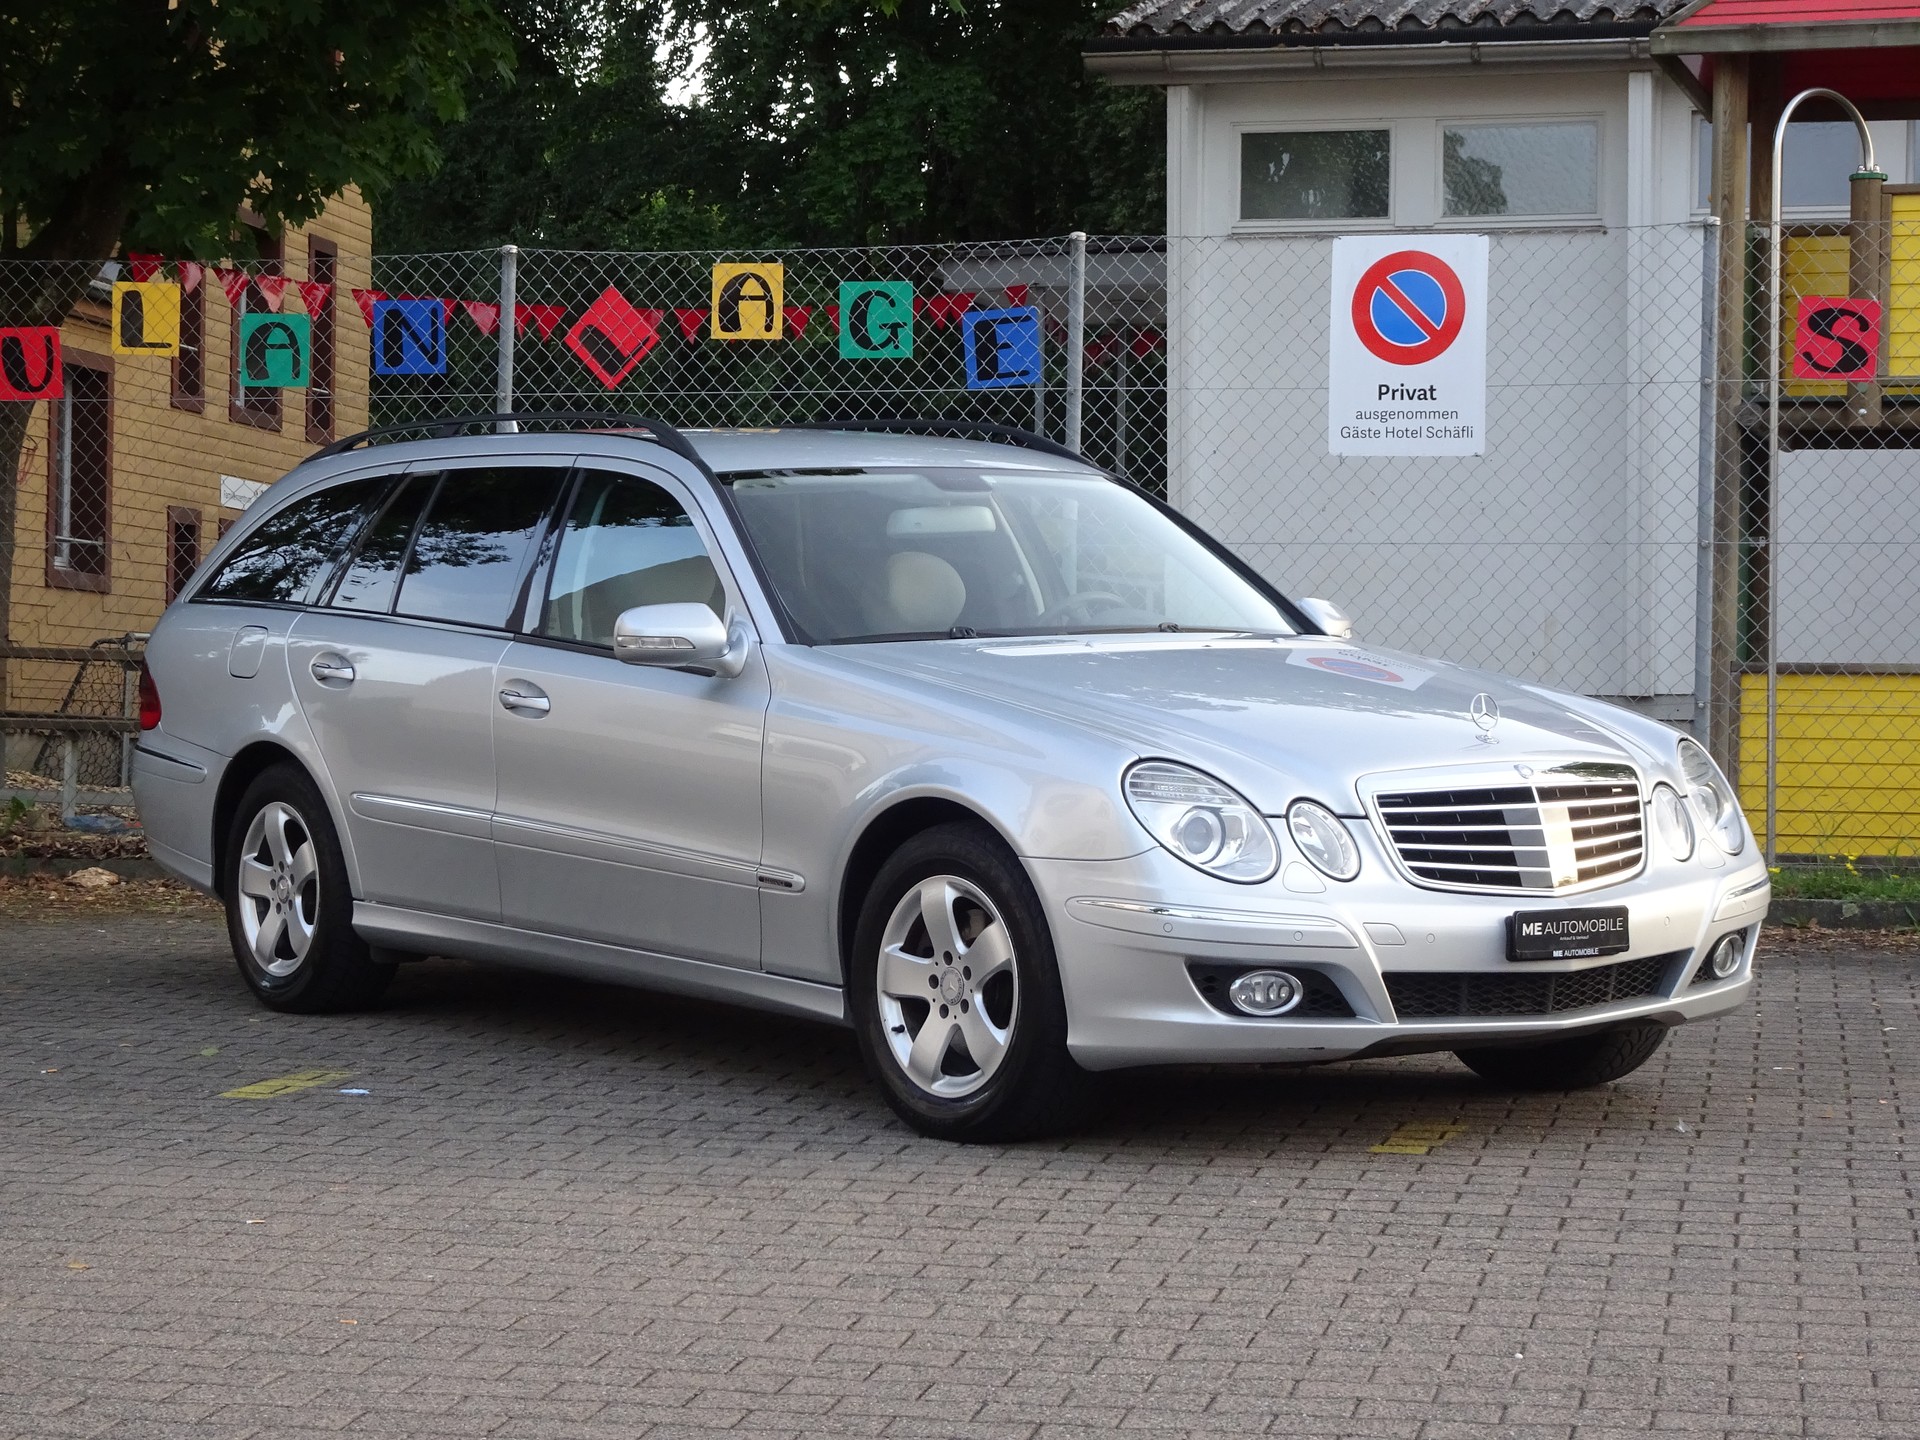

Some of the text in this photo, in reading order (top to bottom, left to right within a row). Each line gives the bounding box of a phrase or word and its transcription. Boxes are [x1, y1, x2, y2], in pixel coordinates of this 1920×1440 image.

[120, 289, 172, 348] L
[245, 321, 301, 381] A
[383, 307, 439, 368] N
[718, 271, 774, 333] A
[849, 289, 908, 351] G
[974, 315, 1032, 381] E
[1802, 308, 1870, 373] S
[1377, 383, 1437, 401] Privat
[1355, 409, 1459, 424] ausgenommen
[1340, 425, 1474, 439] Gäste Hotel Schäfli
[1522, 917, 1624, 936] ME AUTOMOBILE
[1553, 947, 1599, 957] ME AUTOMOBILE
